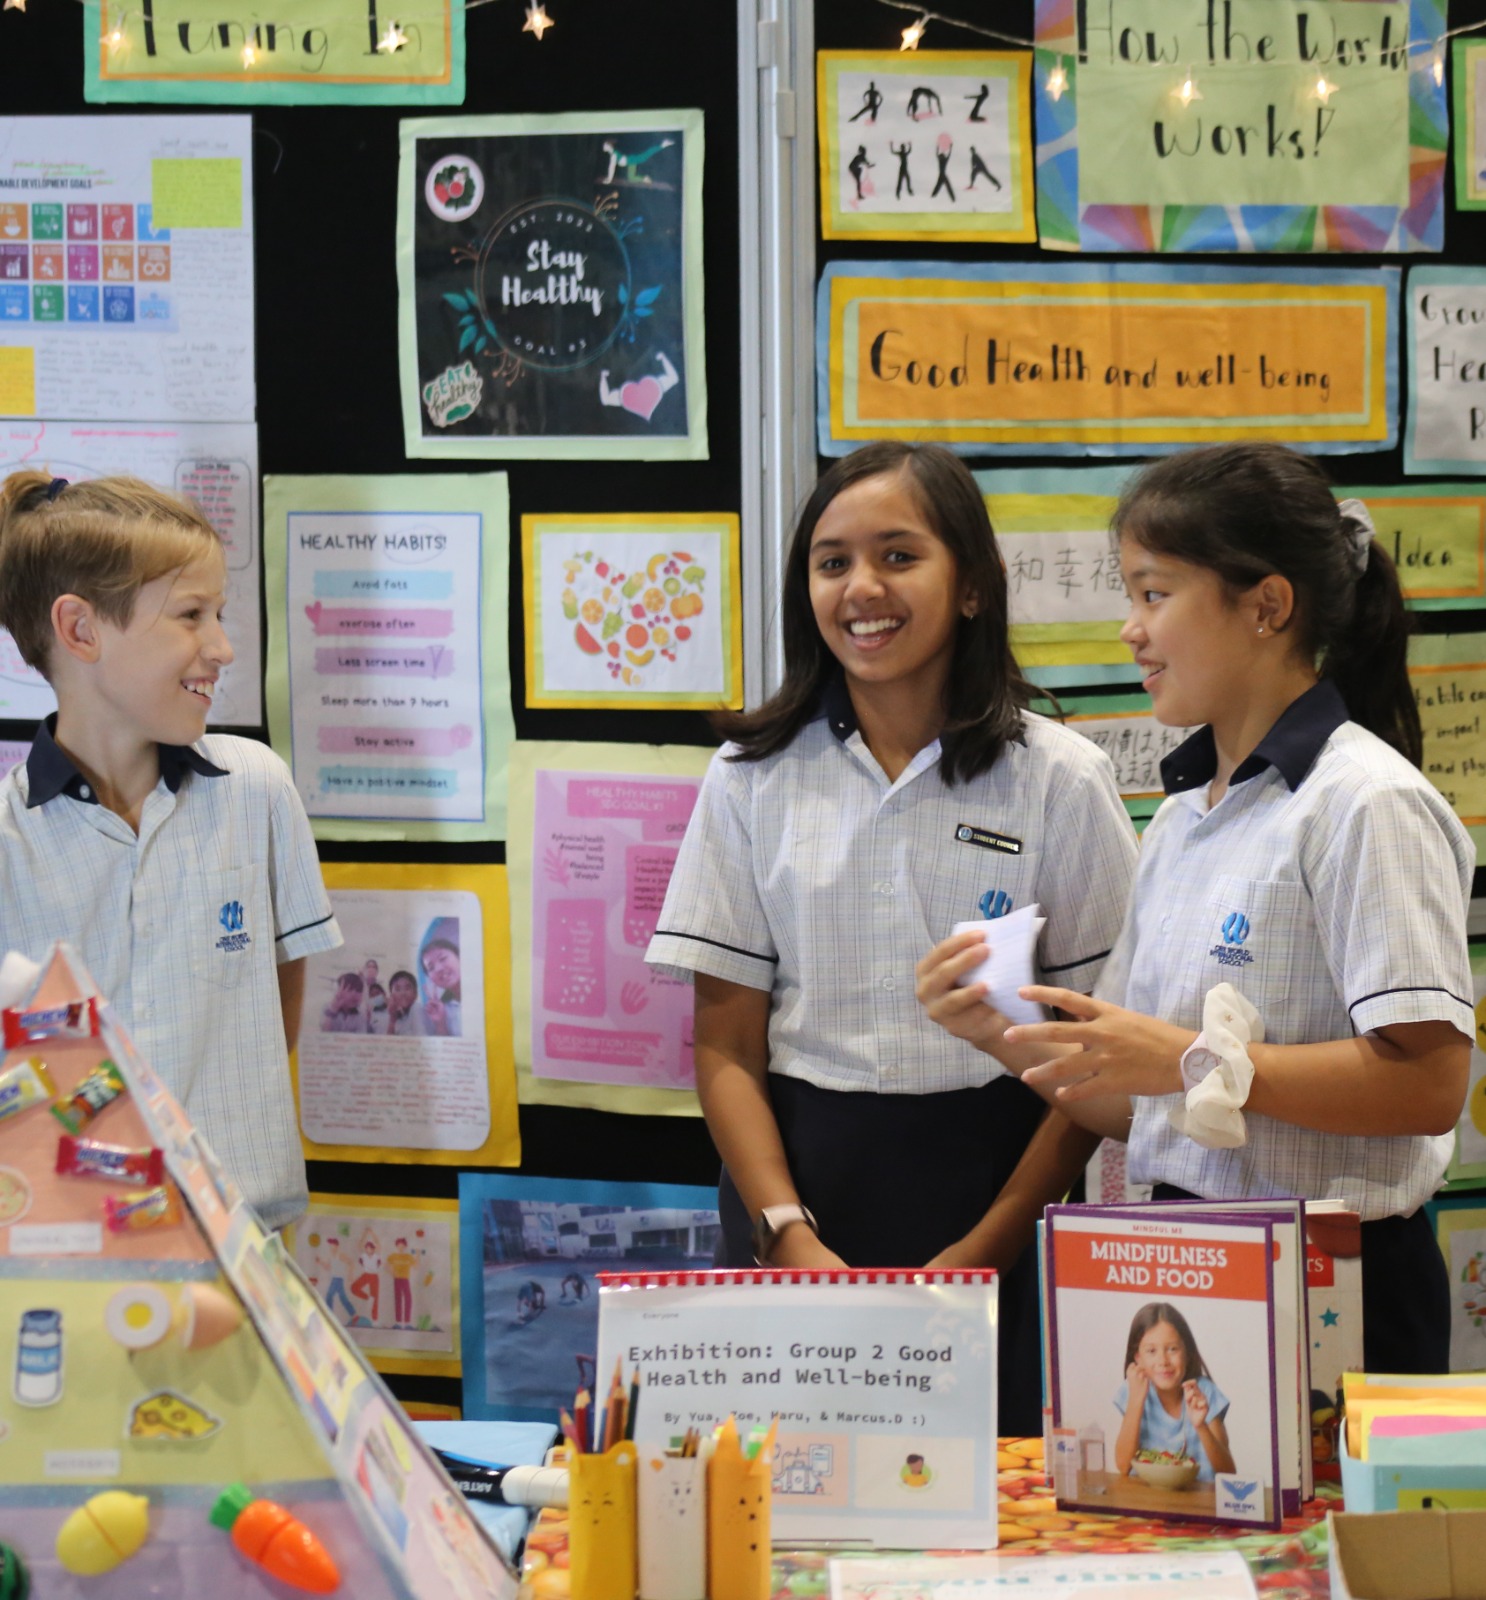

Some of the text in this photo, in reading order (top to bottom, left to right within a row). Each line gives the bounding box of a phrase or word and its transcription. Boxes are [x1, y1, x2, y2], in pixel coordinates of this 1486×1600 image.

[1076, 0, 1179, 65] How
[1197, 0, 1277, 67] the
[21, 178, 69, 190] DEVELOPMENT
[70, 178, 93, 190] GOALS
[526, 239, 588, 281] Stay
[501, 273, 605, 317] Healthy
[870, 328, 1331, 404] Good Health and well-being
[439, 368, 463, 395] EAT
[300, 533, 447, 551] HEALTHY HABITS!
[1393, 530, 1454, 568] Idea
[352, 579, 380, 591] Avoid
[339, 618, 416, 630] exercise often
[338, 657, 426, 668] Less screen time
[321, 695, 348, 709] Sleep
[353, 697, 377, 707] more
[382, 696, 405, 707] than
[420, 696, 450, 708] hours
[354, 736, 415, 748] Stay active
[586, 786, 678, 801] HEALTHY HABITS
[1132, 1224, 1184, 1235] MINDFUL ME
[1090, 1240, 1228, 1268] MINDFULNESS
[1106, 1264, 1214, 1290] AND FOOD
[642, 1311, 680, 1321] Everyone
[628, 1341, 953, 1364] Exhibition: Group 2 Good
[646, 1367, 933, 1393] Health and Well-being
[664, 1411, 681, 1426] By
[688, 1411, 721, 1424] Yua,
[819, 1411, 829, 1422] &
[836, 1411, 904, 1426] Marcus.D
[911, 1413, 927, 1428] :)
